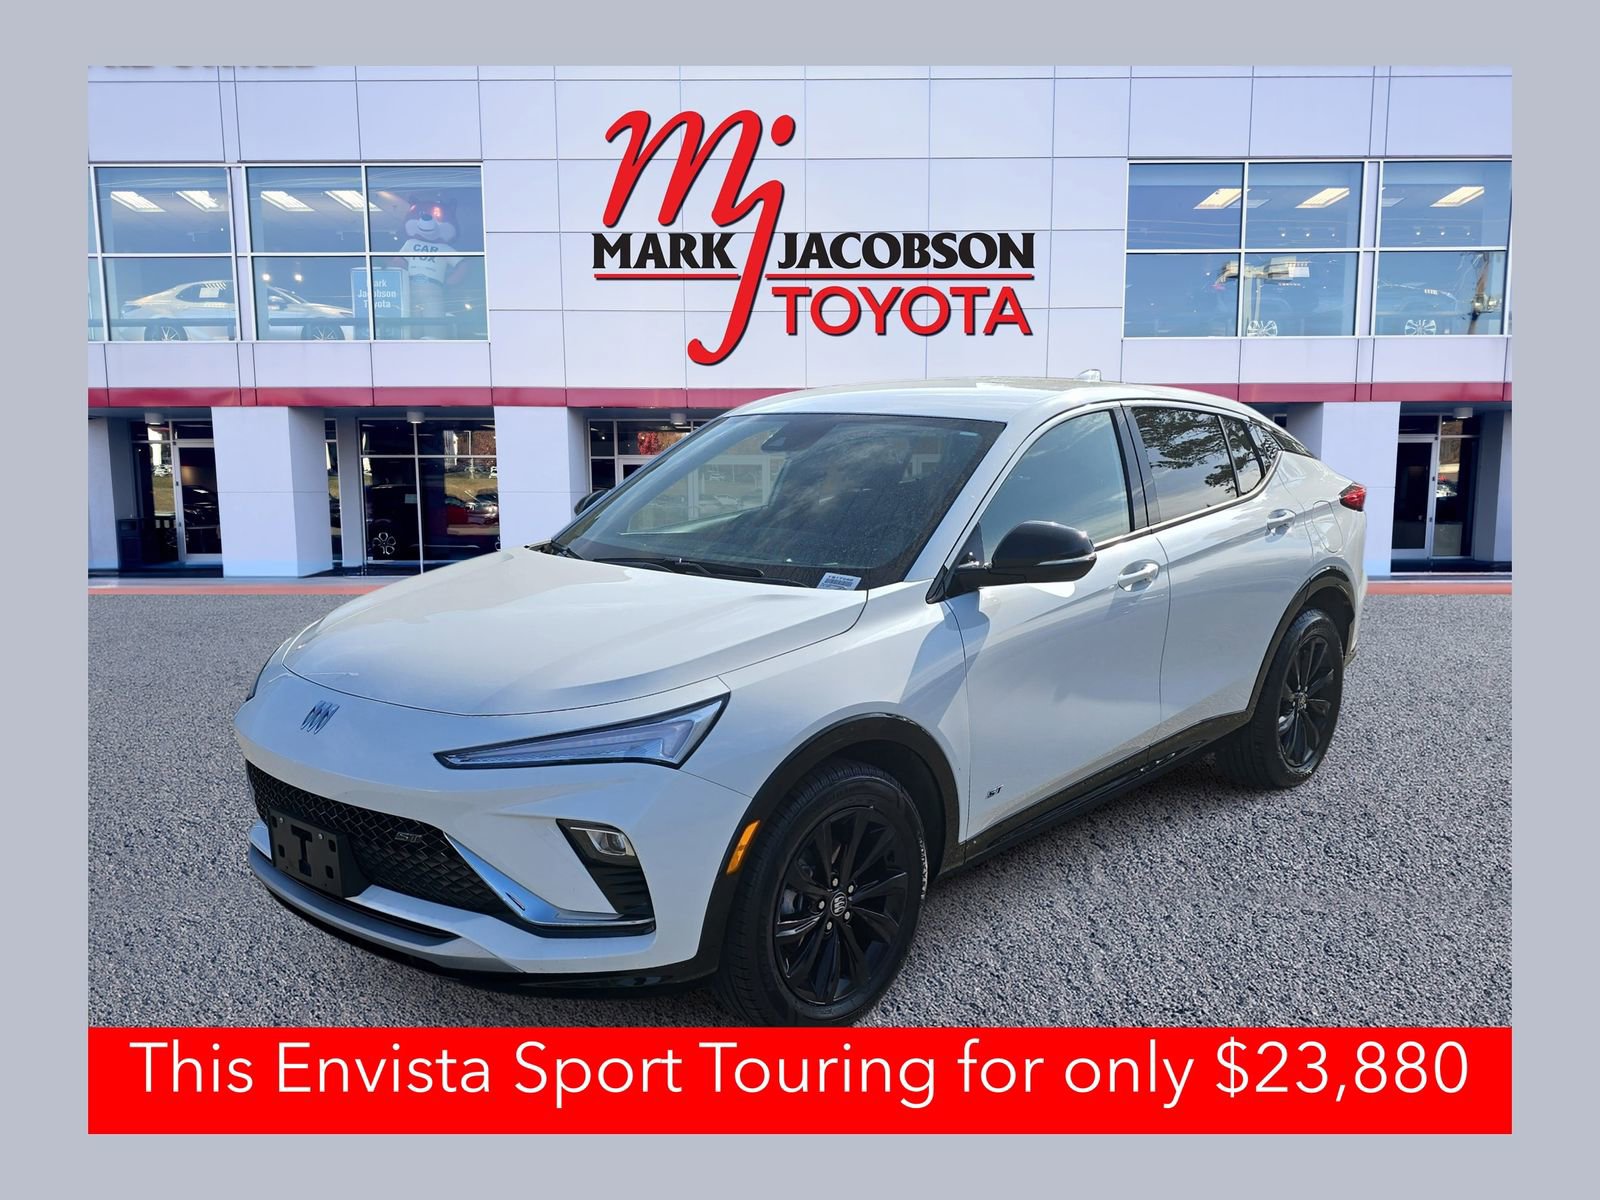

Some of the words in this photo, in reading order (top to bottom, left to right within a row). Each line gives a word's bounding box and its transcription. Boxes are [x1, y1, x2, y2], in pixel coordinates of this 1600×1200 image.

[592, 232, 736, 269] MARK
[777, 232, 1035, 269] JACOBSON
[357, 289, 397, 298] Jaobson
[363, 299, 391, 309] Tyota
[771, 285, 1034, 336] TOYOTA
